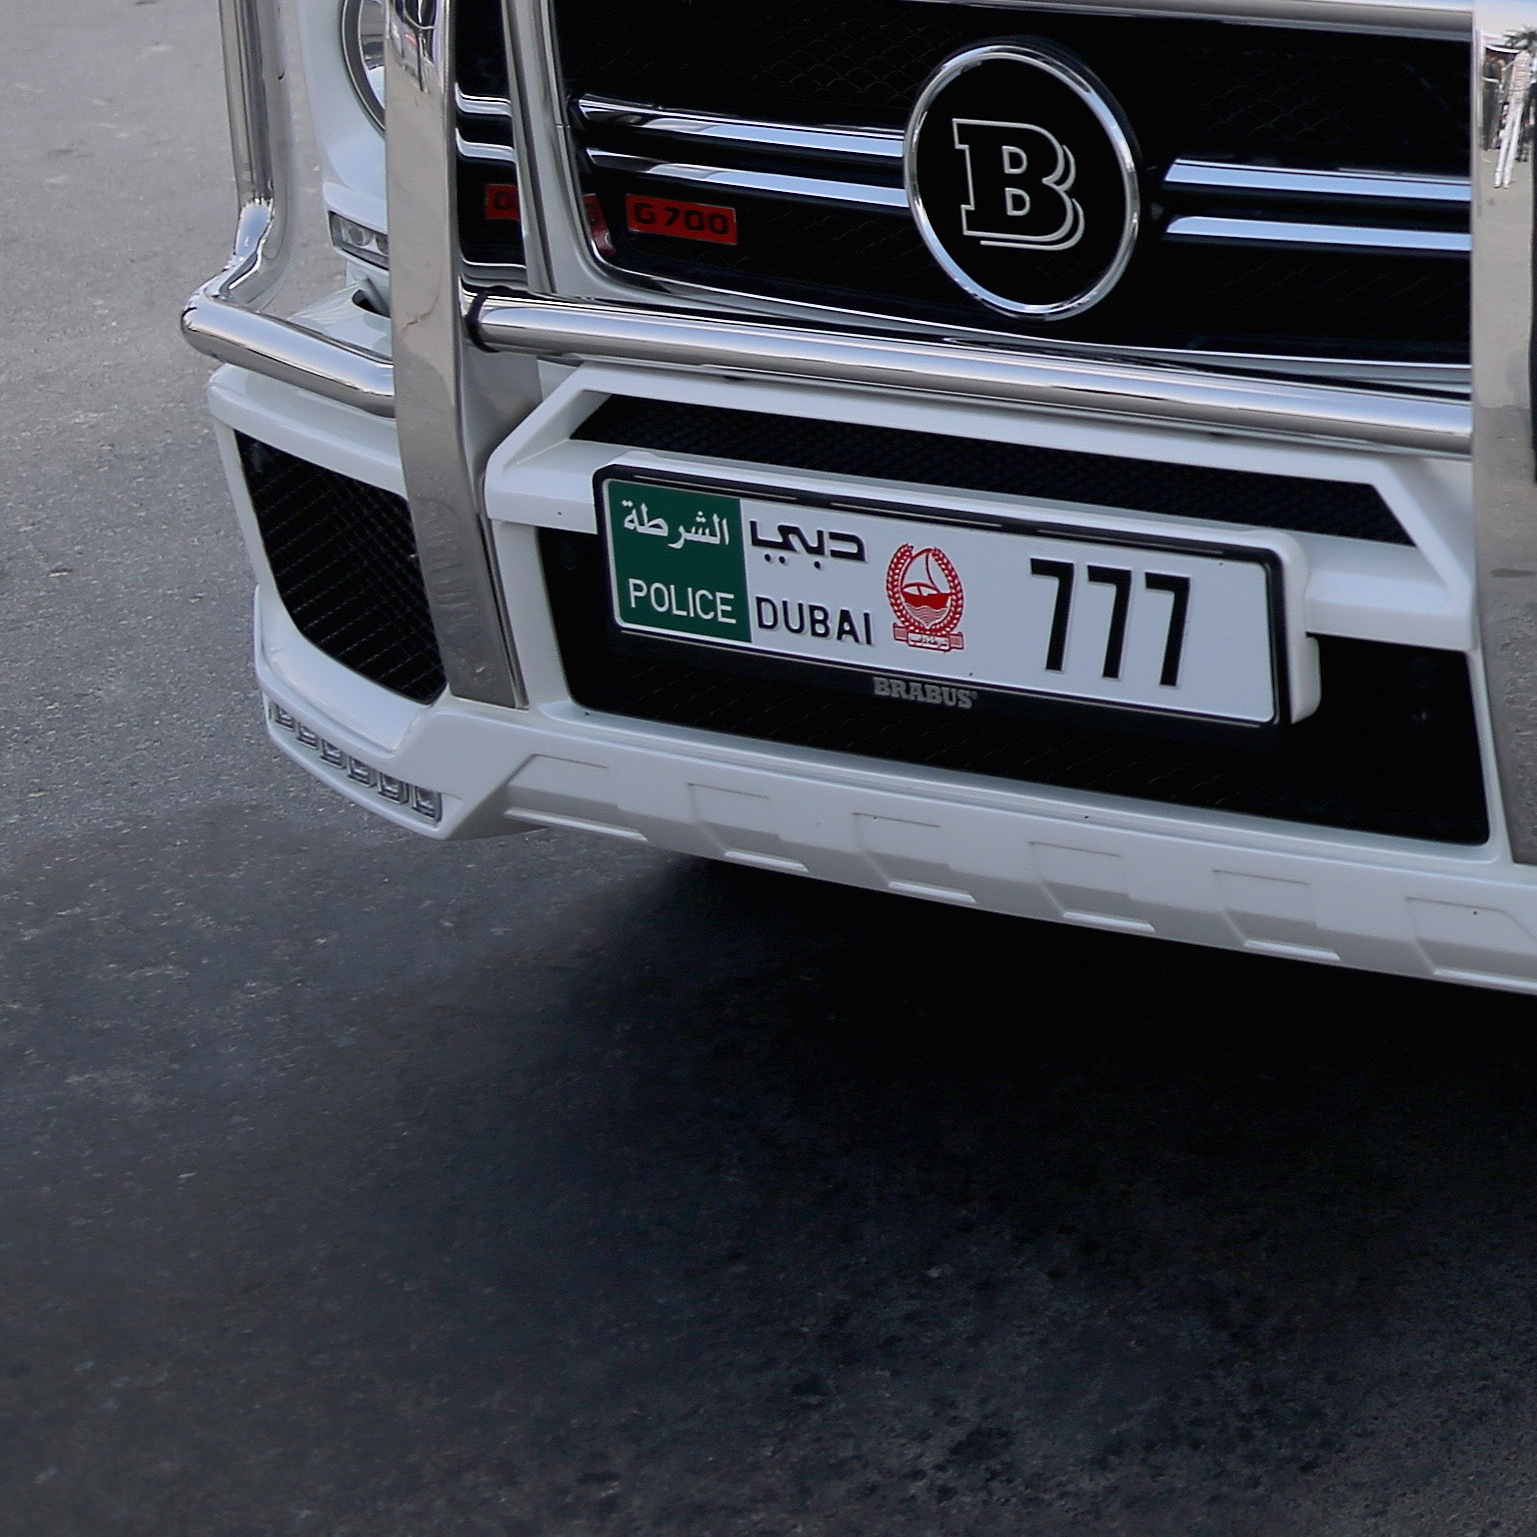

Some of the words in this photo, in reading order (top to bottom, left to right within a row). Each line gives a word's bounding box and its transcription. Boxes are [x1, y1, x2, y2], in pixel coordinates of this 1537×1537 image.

[952, 117, 1086, 251] B
[633, 200, 657, 230] G
[659, 201, 731, 237] 700
[621, 499, 732, 550] الشرطة
[748, 516, 868, 571] دبي
[628, 576, 738, 625] POLICE
[755, 594, 874, 646] DUBAI
[1028, 556, 1192, 687] 777
